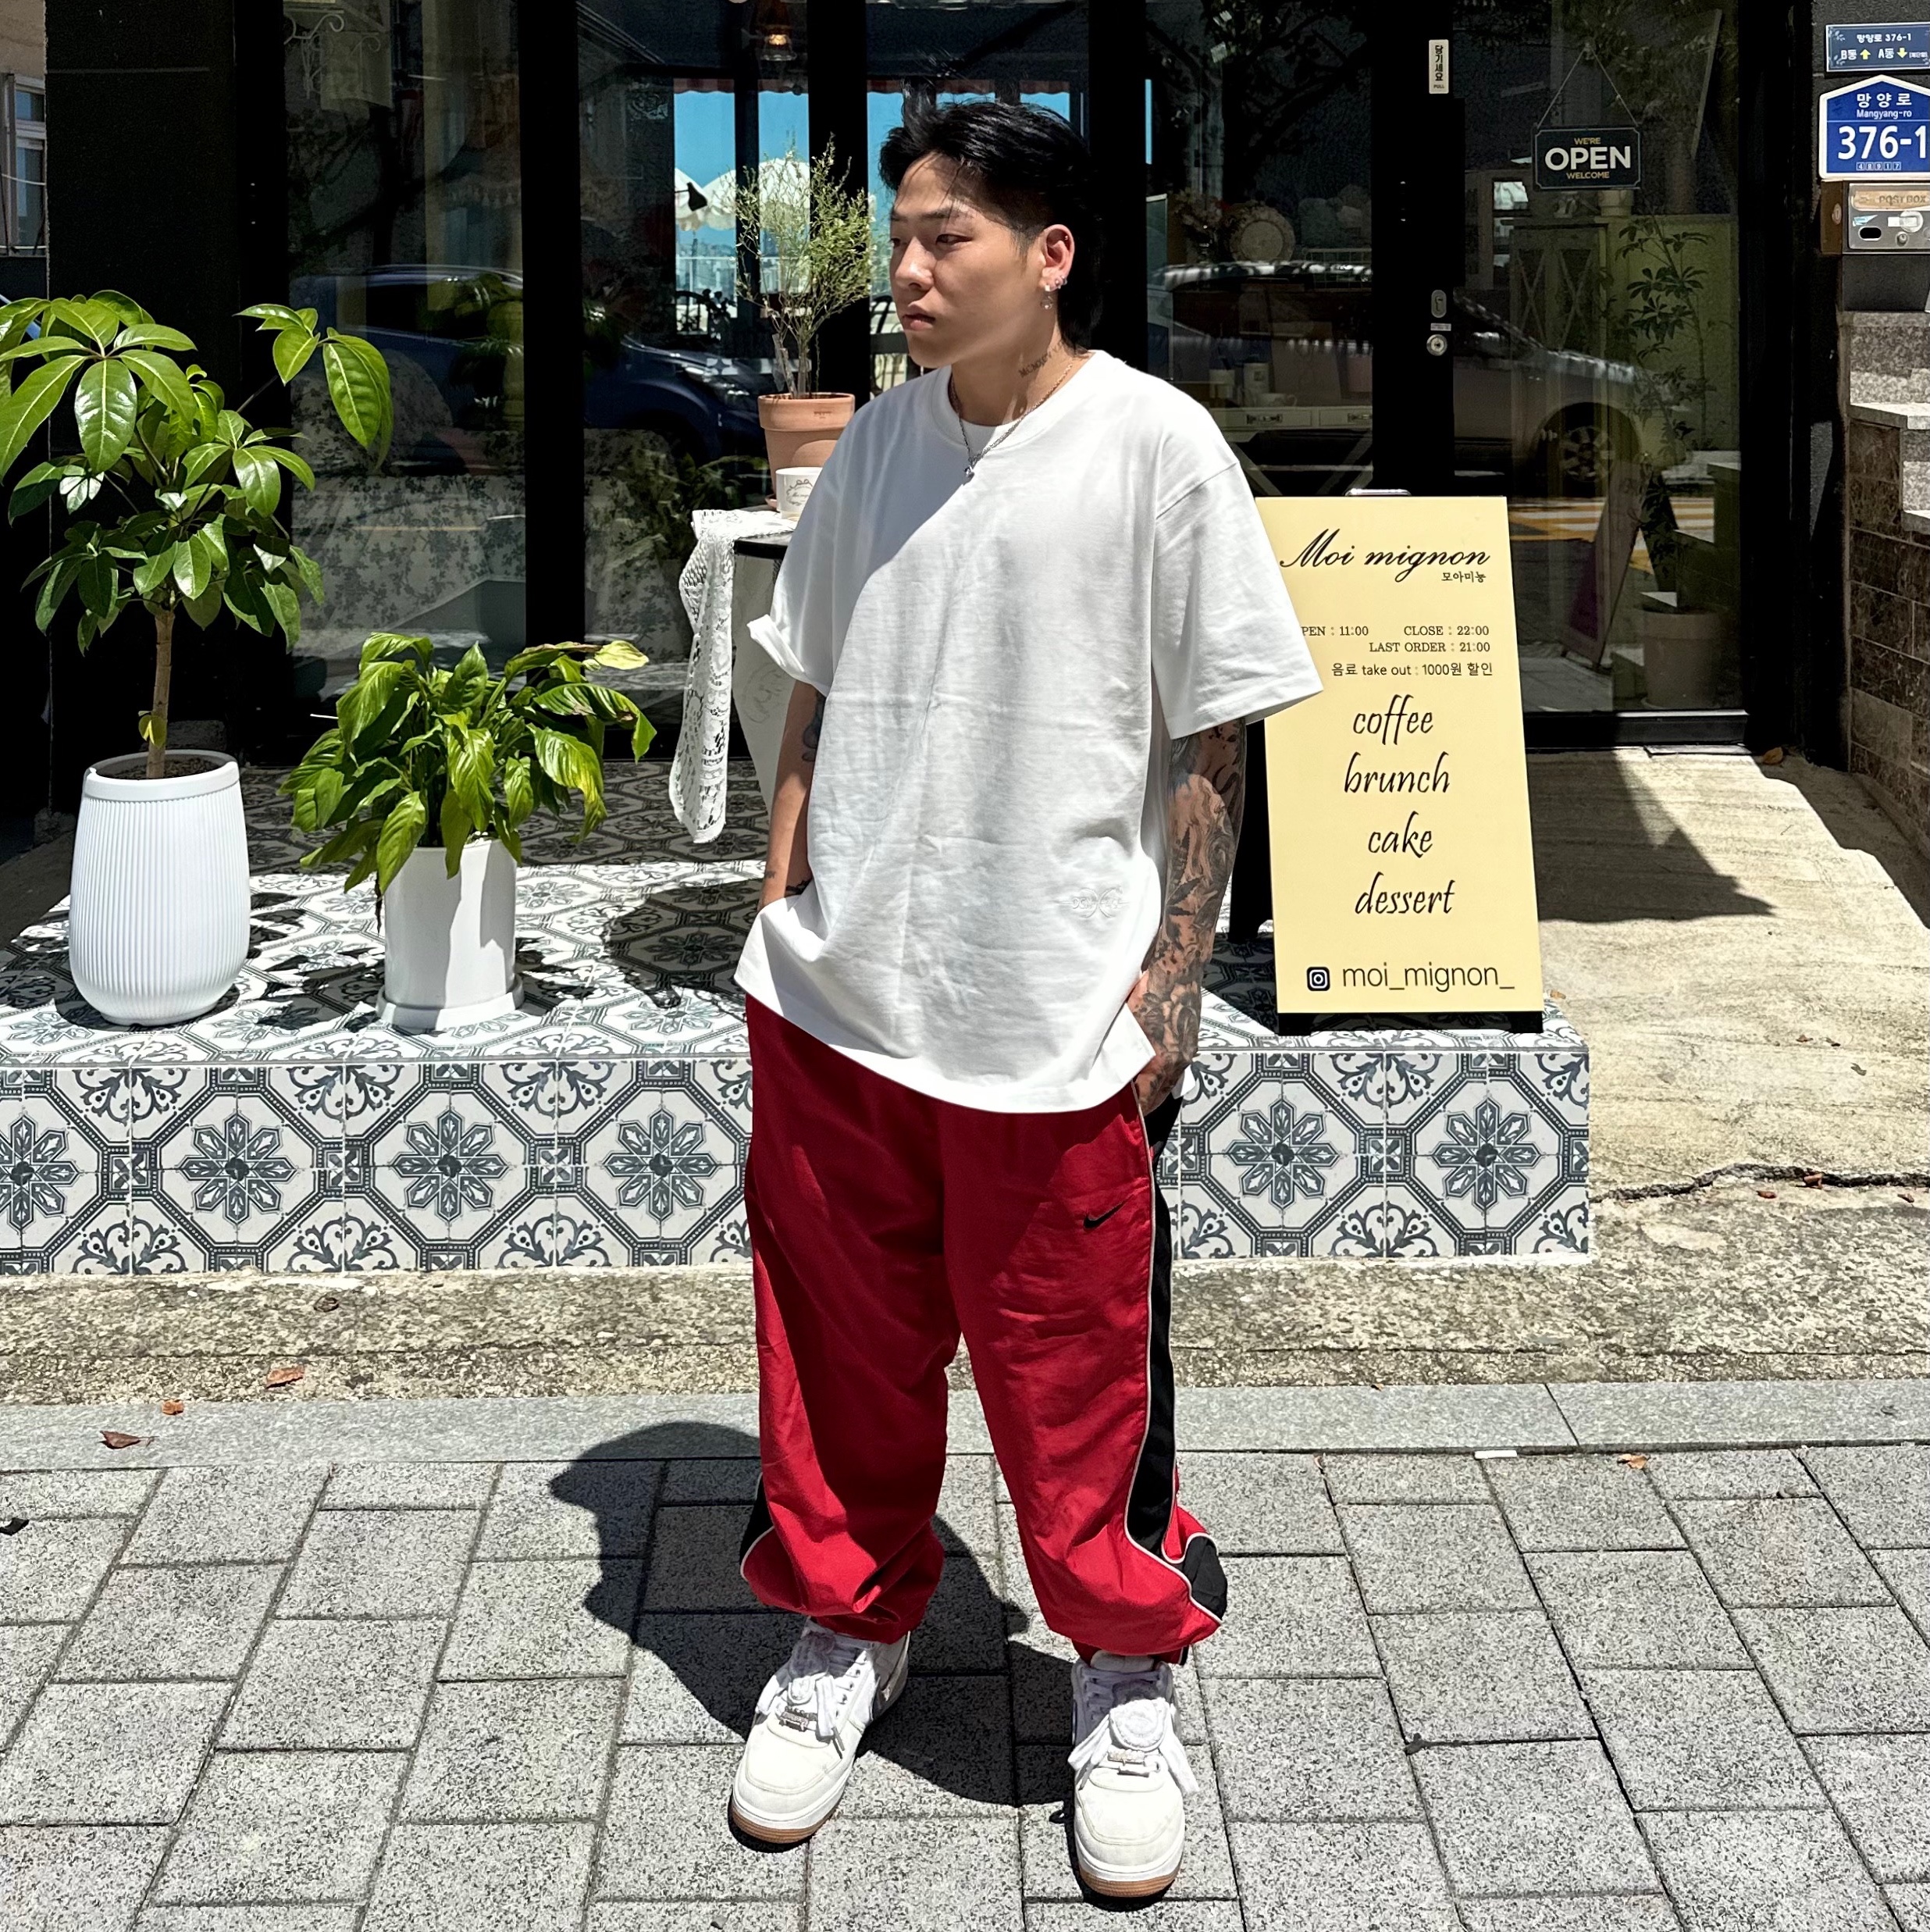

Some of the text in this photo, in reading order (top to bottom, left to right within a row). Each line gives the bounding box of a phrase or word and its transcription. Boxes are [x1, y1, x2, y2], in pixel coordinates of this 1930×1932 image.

[1885, 33, 1911, 42] 376-1
[1434, 45, 1444, 81] 당기세요
[1857, 92, 1912, 108] 망양로
[1857, 109, 1912, 119] Mangyang-ro
[1574, 137, 1601, 145] WE'RE
[1837, 125, 1927, 160] 376-1
[1544, 146, 1631, 171] OPEN
[1566, 171, 1610, 180] WELCOME
[1878, 194, 1927, 204] POST BOX
[1279, 528, 1490, 583] Moi mignon
[1302, 626, 1326, 636] PEN
[1339, 626, 1369, 636] 11:00
[1403, 626, 1444, 636] CLOSE
[1456, 626, 1490, 636] 22:00
[1369, 642, 1401, 653] LAST
[1404, 642, 1447, 653] ORDER
[1459, 642, 1490, 653] 21:00
[1331, 662, 1358, 676] 음료
[1362, 664, 1387, 675] take
[1391, 665, 1412, 675] out
[1422, 662, 1462, 676] 1000원
[1466, 661, 1493, 676] 할인
[1352, 693, 1433, 746] coffee
[1344, 750, 1451, 793] brunch
[1368, 810, 1433, 859] cake
[1355, 871, 1456, 914] dessert
[1342, 961, 1515, 993] moi_mignon_
